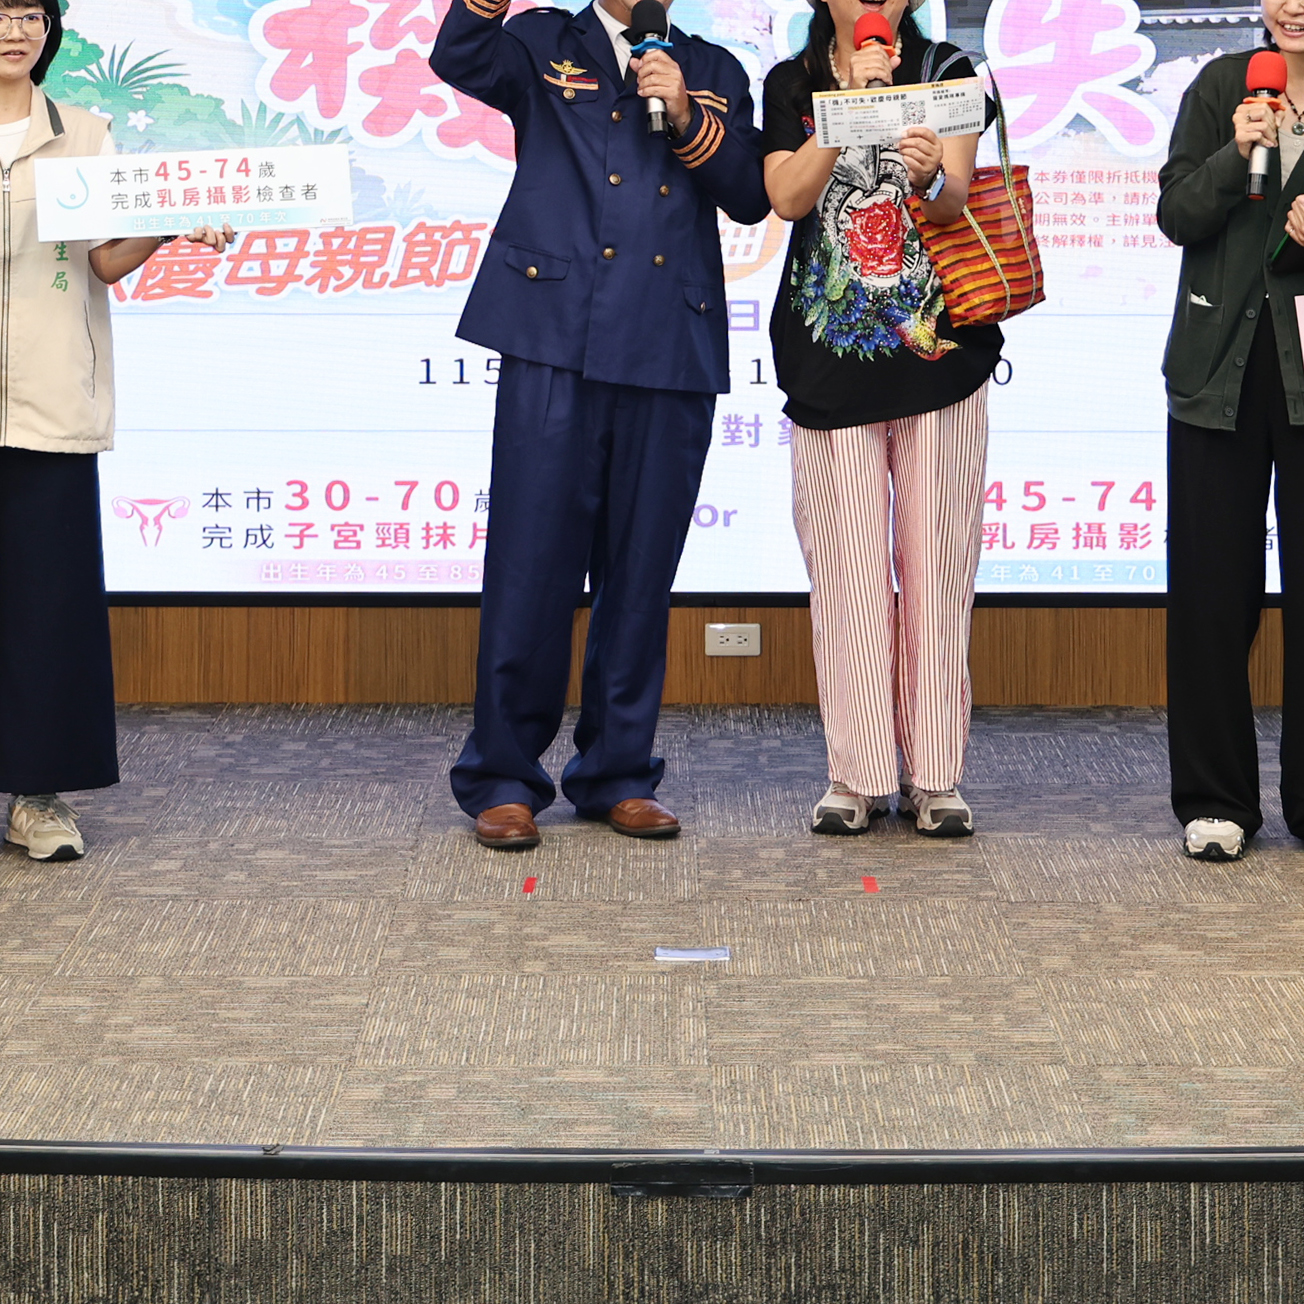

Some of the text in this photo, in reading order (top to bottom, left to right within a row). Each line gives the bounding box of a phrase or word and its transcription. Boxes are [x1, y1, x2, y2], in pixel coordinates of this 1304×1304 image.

[109, 157, 276, 185] 本市45-74歲
[111, 183, 318, 211] 完成乳房攝影檢查者
[981, 522, 1167, 551] 乳房攝影
